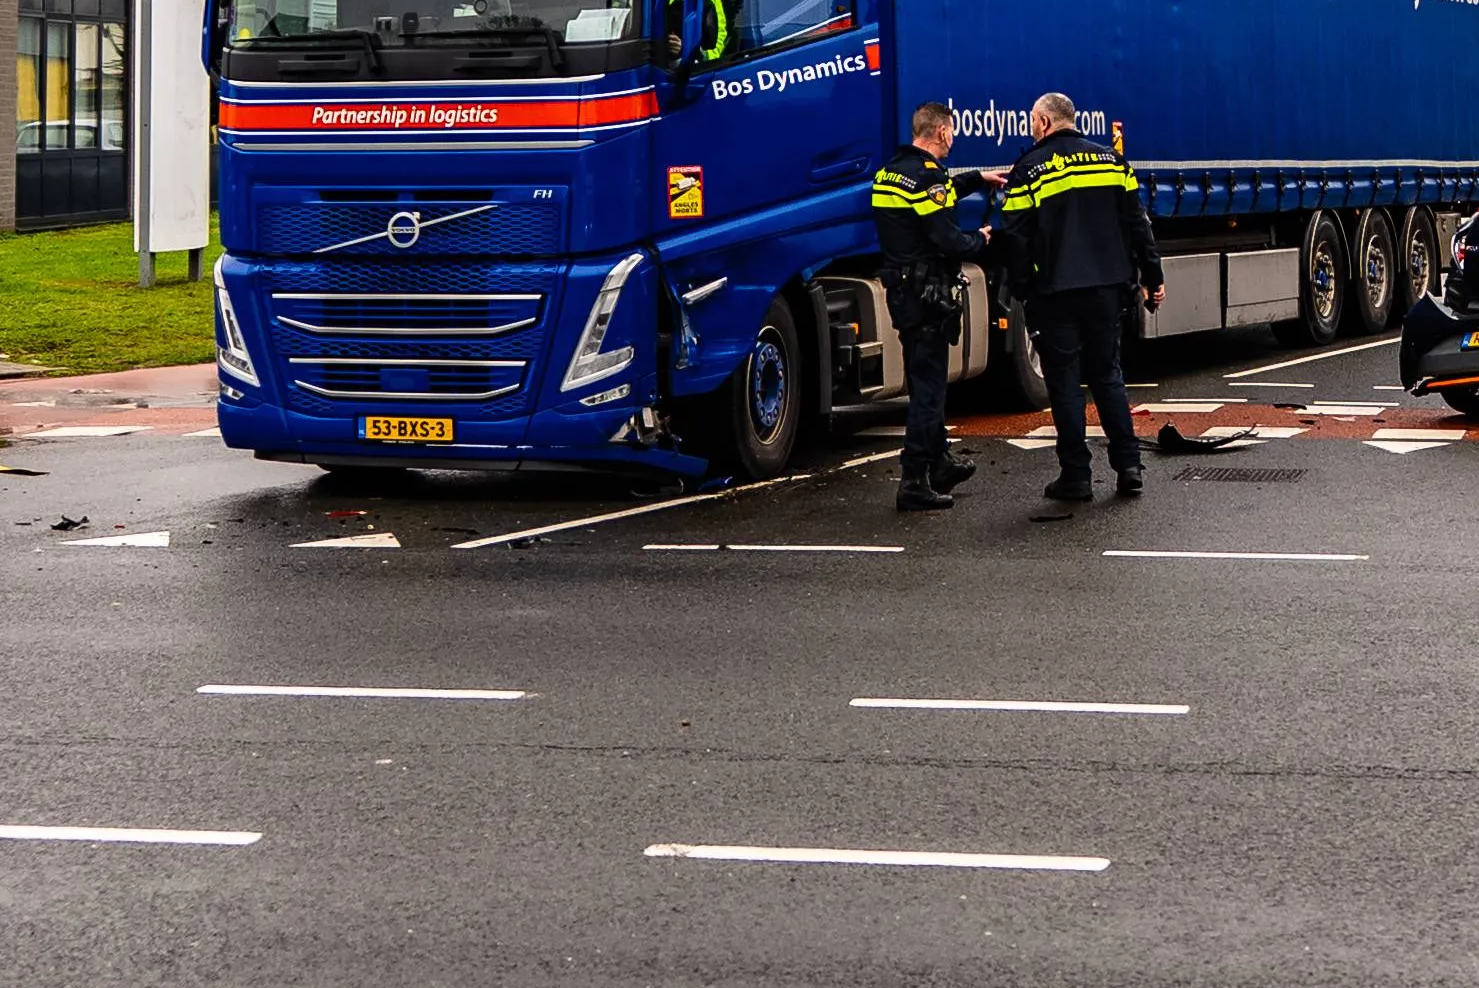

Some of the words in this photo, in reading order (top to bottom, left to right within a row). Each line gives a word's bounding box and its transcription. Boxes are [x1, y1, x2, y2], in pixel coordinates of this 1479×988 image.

[712, 78, 753, 100] Bos
[756, 54, 866, 92] Dynamics
[312, 106, 406, 128] Partnership
[410, 106, 425, 123] in
[429, 105, 498, 128] logistics
[533, 189, 553, 199] FH
[372, 419, 445, 437] 53-BXS-3
